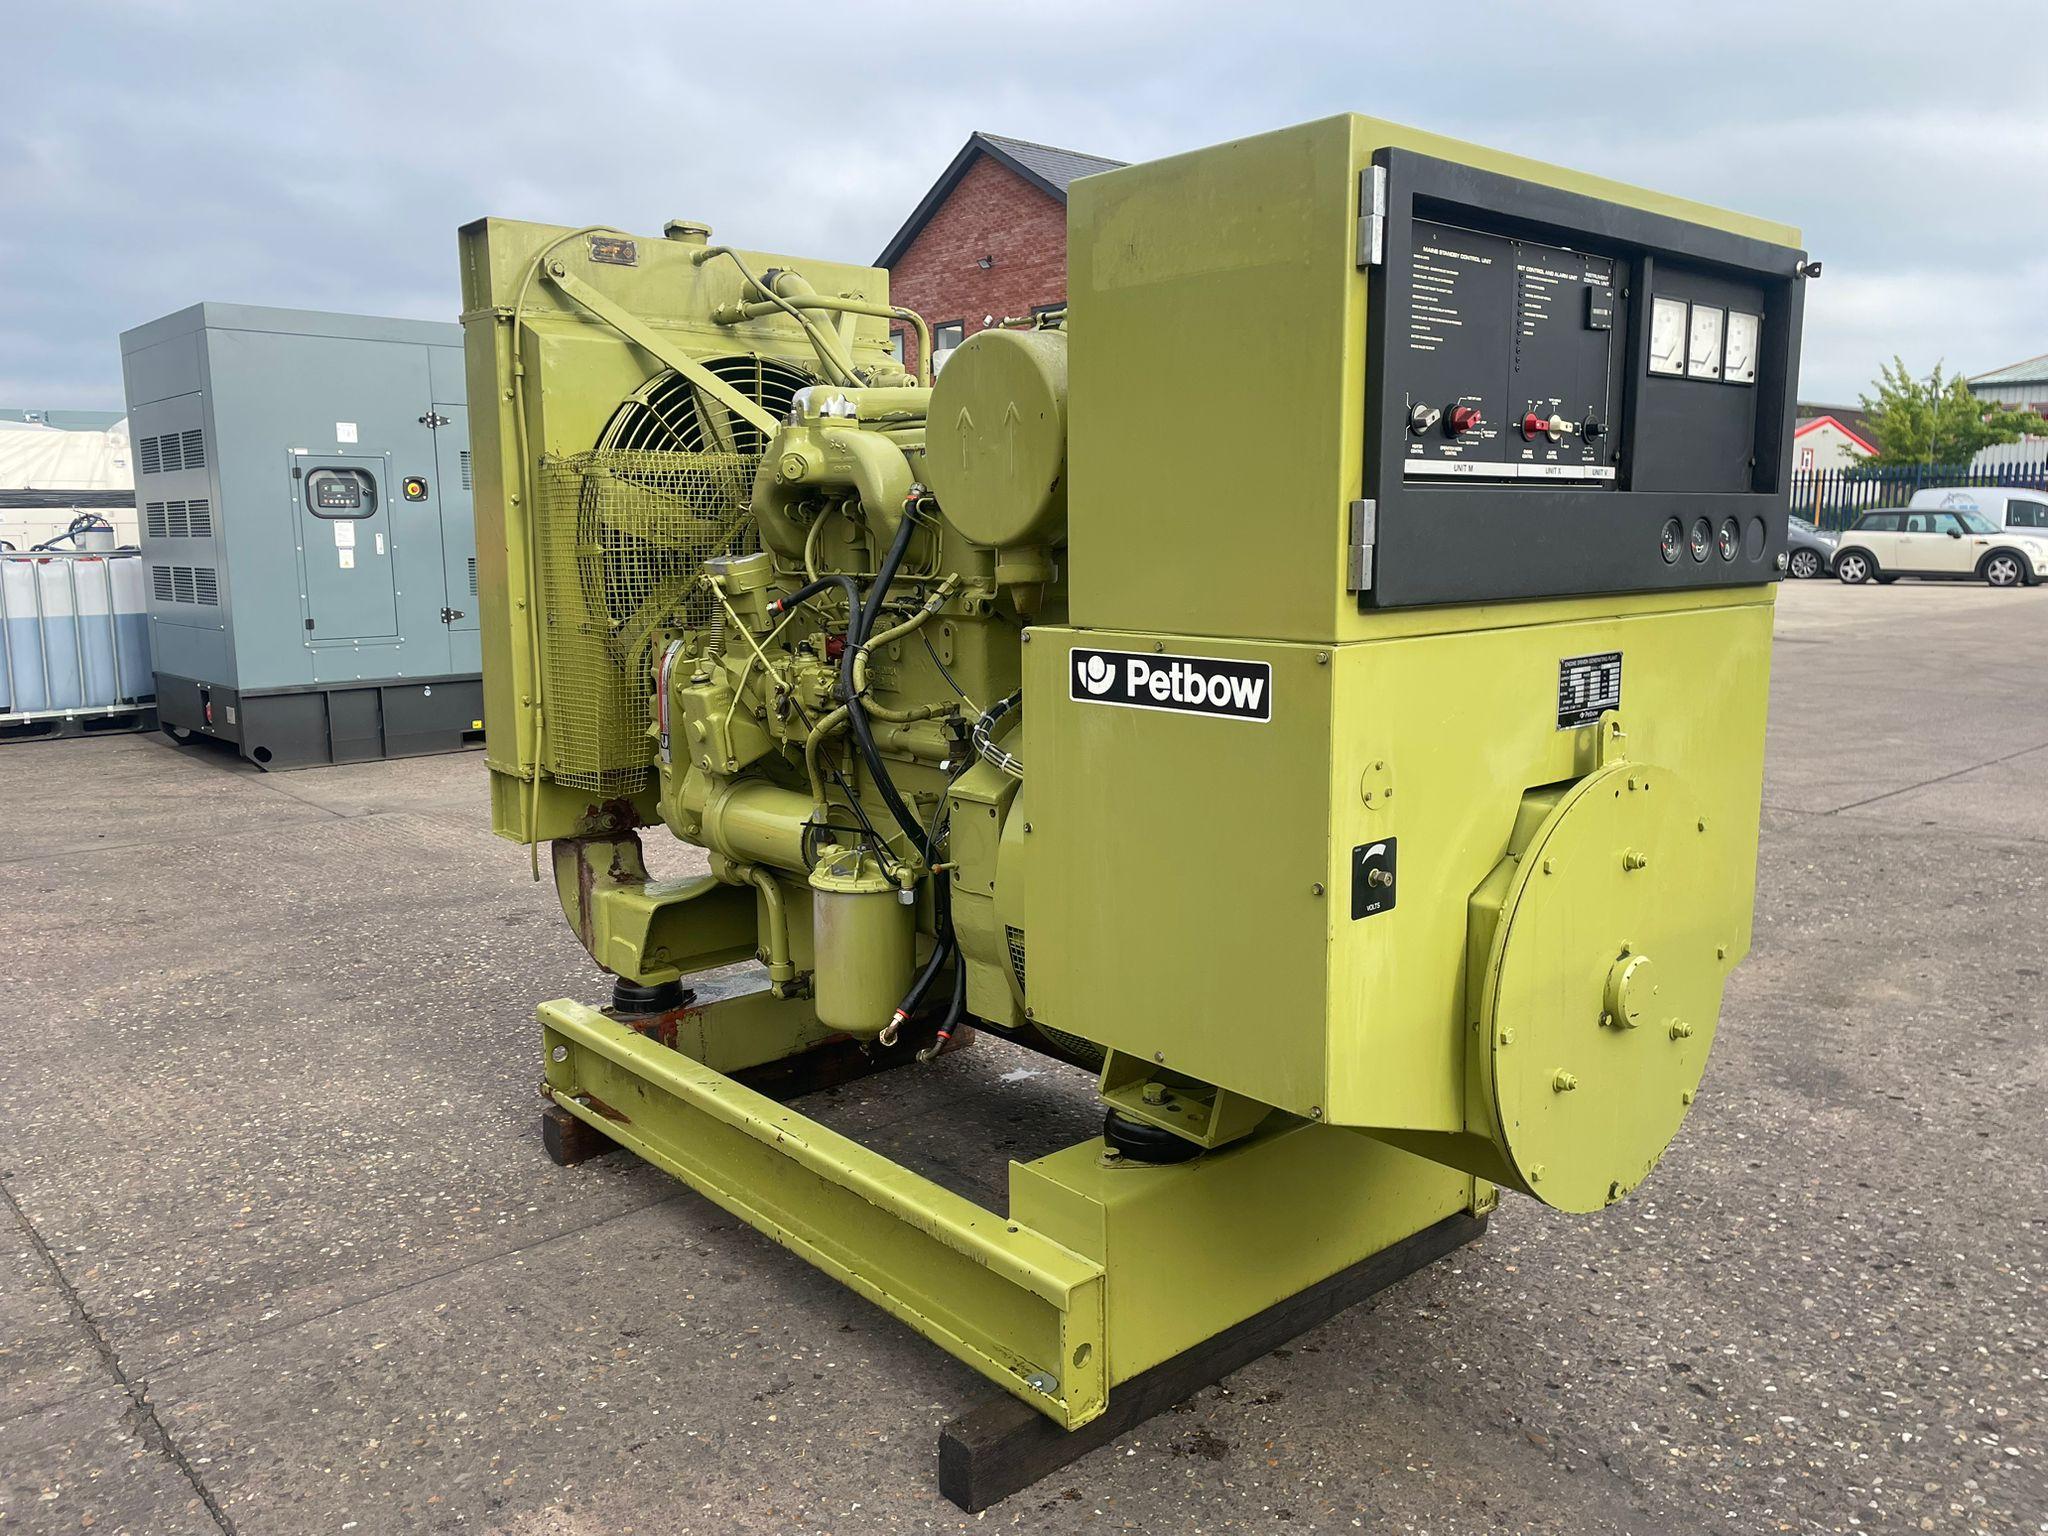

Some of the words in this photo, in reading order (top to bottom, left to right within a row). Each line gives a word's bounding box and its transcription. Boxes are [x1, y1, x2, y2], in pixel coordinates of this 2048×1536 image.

[1423, 246, 1439, 255] MAINS
[1439, 249, 1460, 259] STANDBY
[1460, 253, 1481, 263] CONTROL
[1526, 266, 1544, 275] CONTROL
[1554, 271, 1569, 279] ALARM
[1453, 464, 1467, 472] UNIT
[1545, 467, 1557, 475] UNIT
[1592, 468, 1604, 476] UNIT
[1126, 658, 1265, 710] Petbow
[1366, 901, 1381, 912] VOLTS
